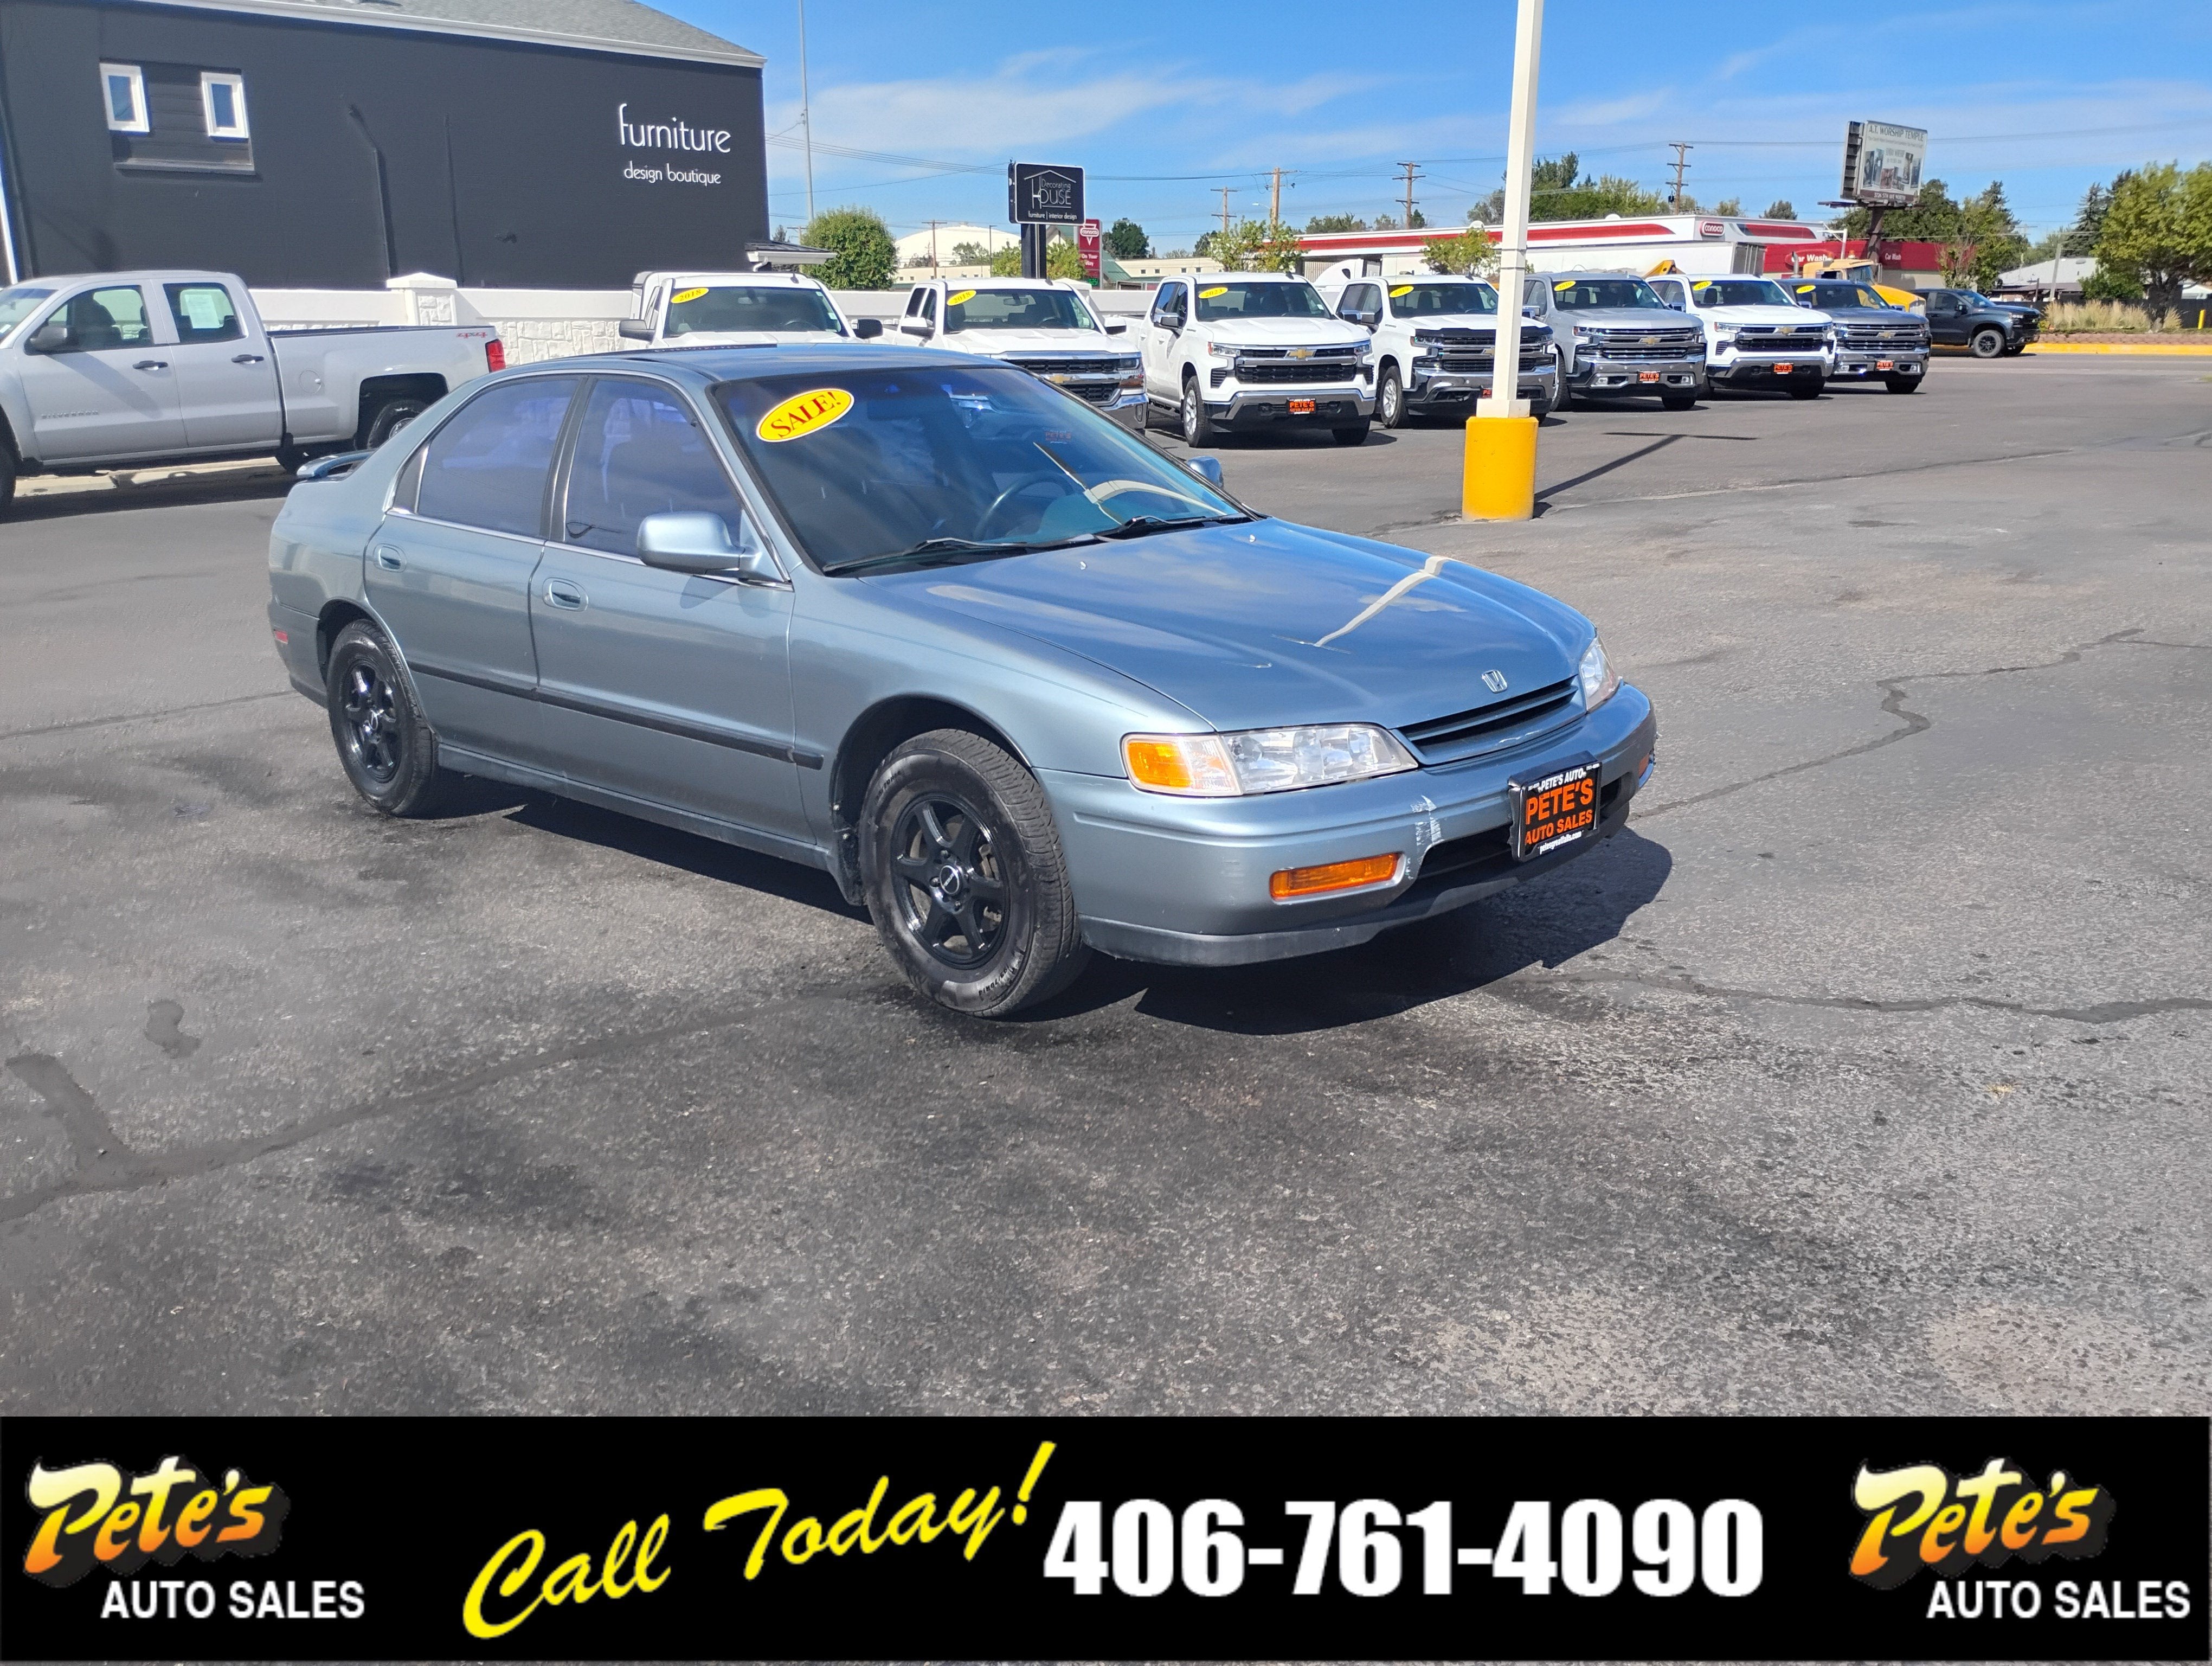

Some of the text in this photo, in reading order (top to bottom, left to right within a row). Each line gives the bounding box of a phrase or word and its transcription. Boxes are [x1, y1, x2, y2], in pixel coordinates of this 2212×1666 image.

[619, 103, 731, 153] furniture
[1880, 126, 1904, 138] WORSHIP
[1905, 130, 1925, 141] TEMPLE
[624, 161, 721, 186] design boutique
[1041, 178, 1071, 190] Decorating
[1032, 176, 1071, 209] HOUSE
[1028, 210, 1045, 219] furniture
[1064, 212, 1077, 221] design
[1806, 254, 1828, 262] Wash
[679, 289, 701, 302] 2018
[954, 292, 971, 303] 2018
[771, 392, 841, 438] SALE!
[1541, 773, 1563, 791] PETE'S
[1564, 767, 1583, 783] AUTO
[1525, 778, 1593, 825] PETE'S
[1525, 809, 1593, 844] AUTO SALES
